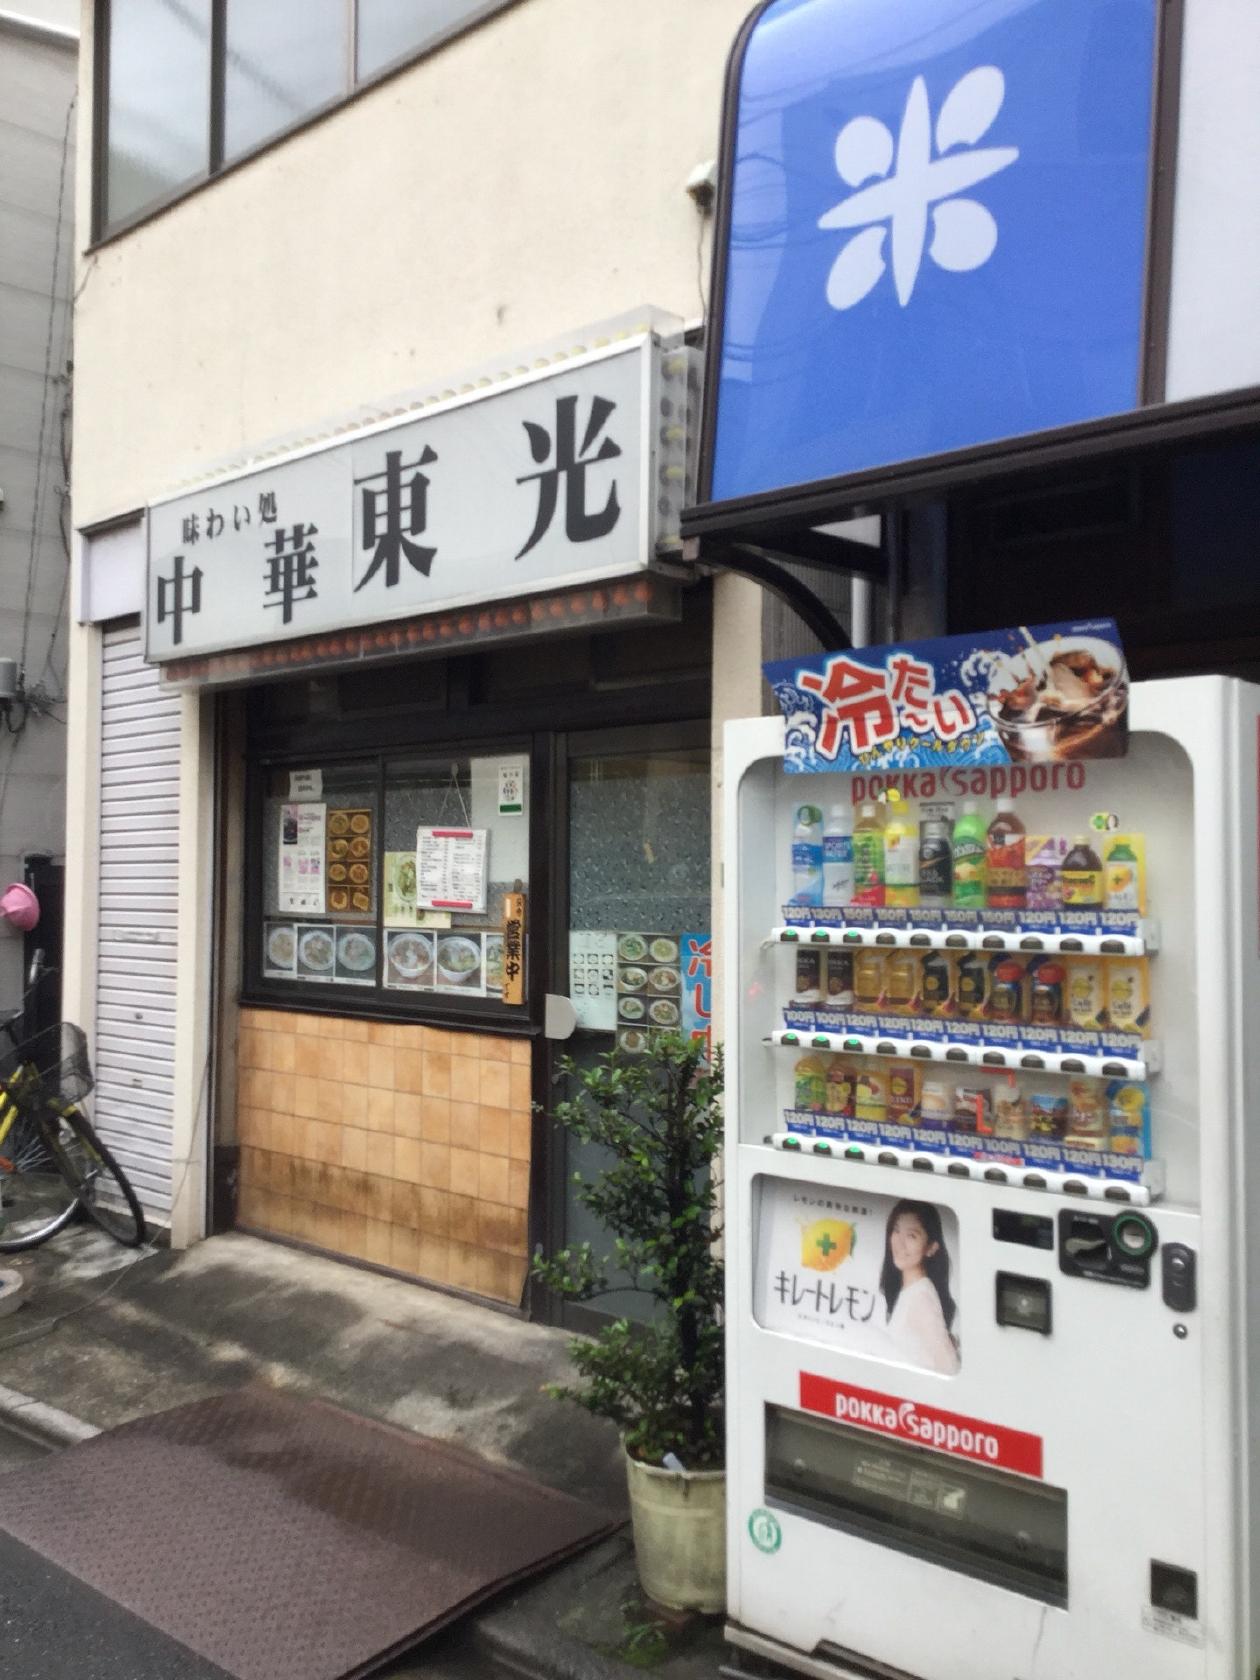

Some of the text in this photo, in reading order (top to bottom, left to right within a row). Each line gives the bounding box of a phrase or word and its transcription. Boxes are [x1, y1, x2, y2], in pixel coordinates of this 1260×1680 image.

[182, 492, 278, 545] 味わい処
[773, 1270, 876, 1323] キレートレモン
